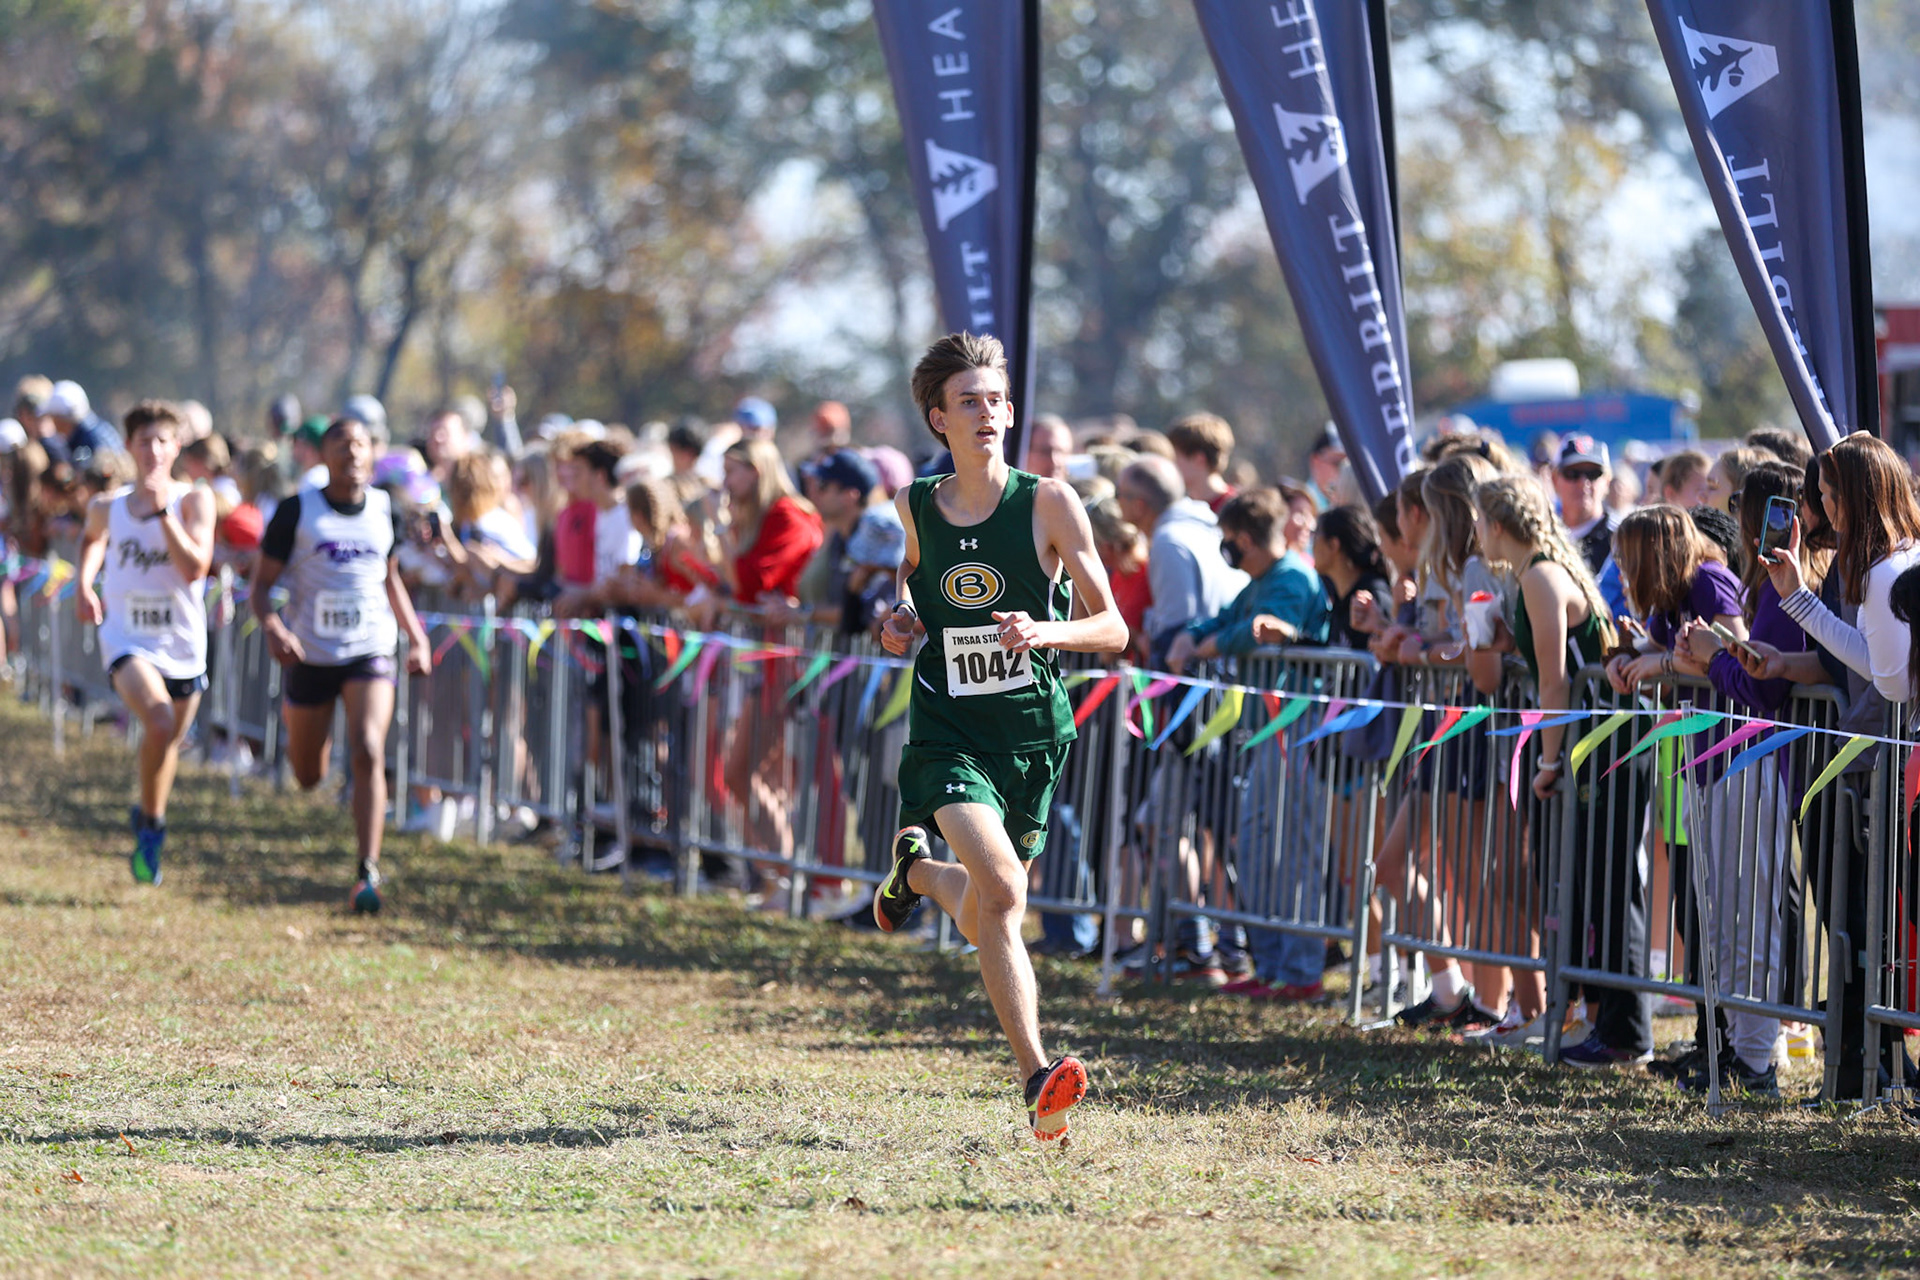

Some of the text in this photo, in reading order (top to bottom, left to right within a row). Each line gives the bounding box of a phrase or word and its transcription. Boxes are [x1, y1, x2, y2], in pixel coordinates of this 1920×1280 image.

[953, 571, 990, 600] B
[952, 634, 981, 646] TMSAA
[982, 632, 1006, 644] STAT
[952, 648, 1025, 684] 1042
